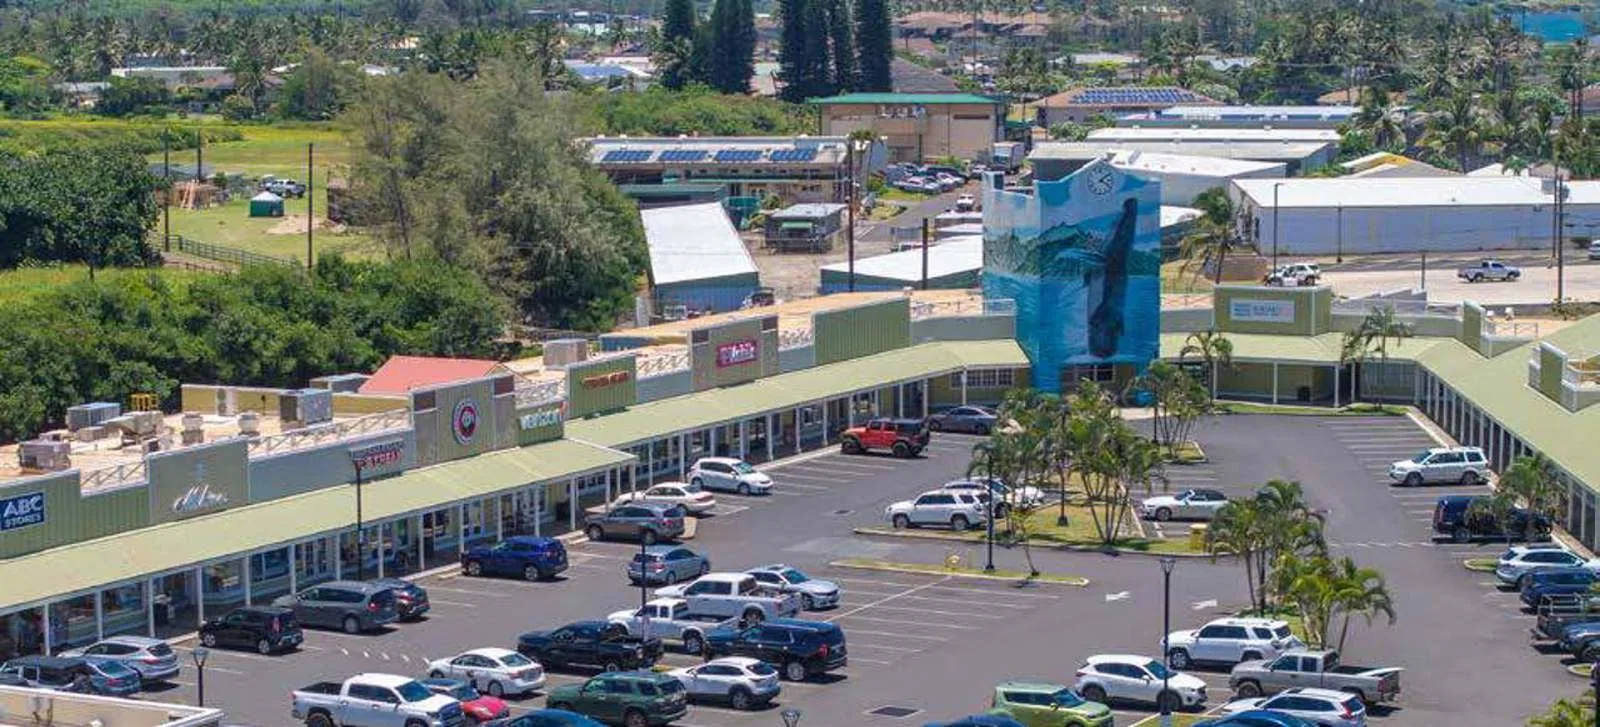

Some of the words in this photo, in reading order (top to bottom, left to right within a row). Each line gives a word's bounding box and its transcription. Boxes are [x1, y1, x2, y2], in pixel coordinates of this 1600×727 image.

[520, 411, 561, 430] verizon
[3, 495, 42, 517] ABC
[4, 512, 42, 528] STORES
